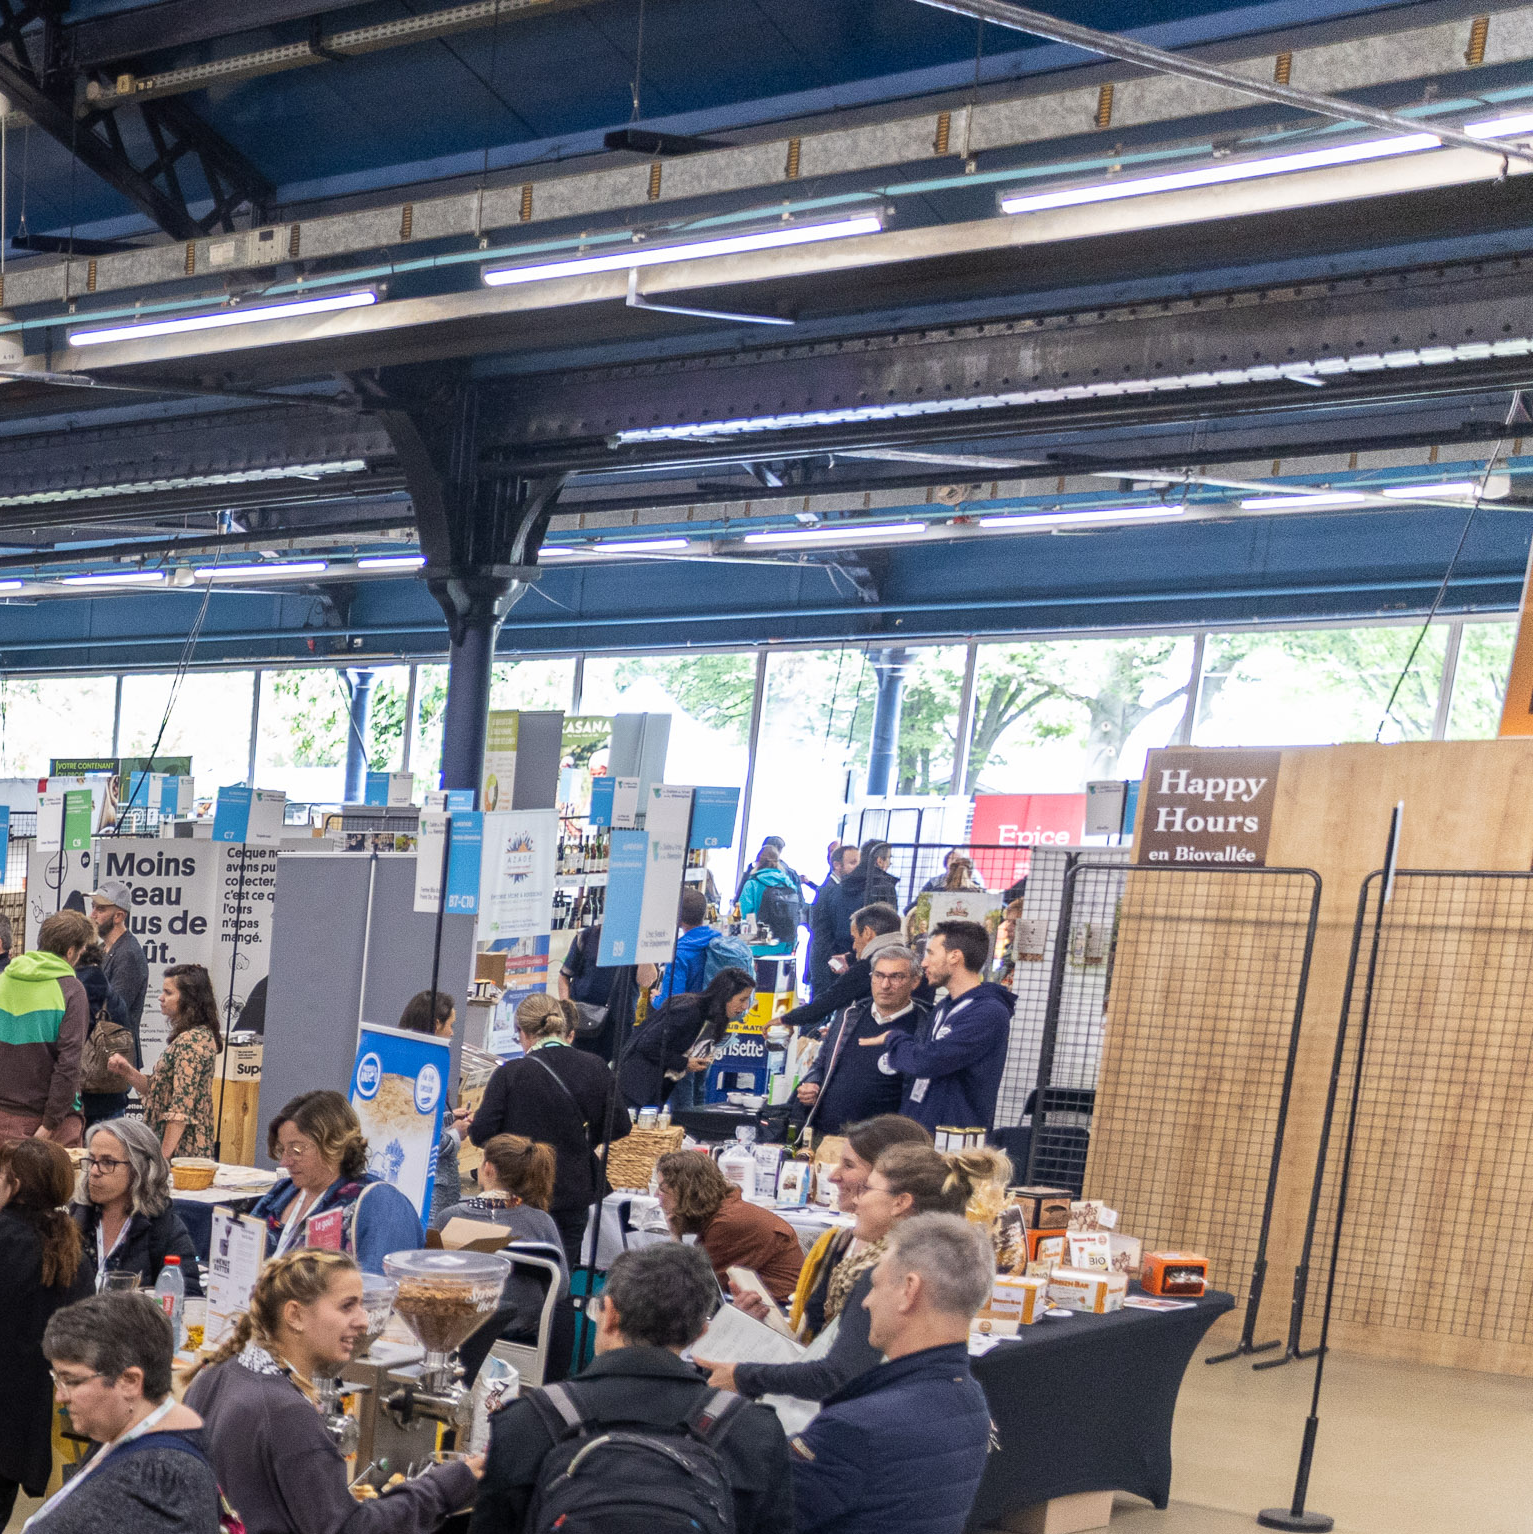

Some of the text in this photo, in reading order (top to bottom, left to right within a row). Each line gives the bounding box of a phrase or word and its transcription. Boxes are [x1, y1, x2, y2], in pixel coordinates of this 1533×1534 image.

[1158, 769, 1268, 802] Happy
[1154, 807, 1259, 833] Hours
[224, 831, 234, 839] C7
[704, 838, 717, 846] C8
[73, 839, 81, 847] C9
[228, 848, 267, 861] Ce que
[1149, 846, 1256, 863] en Biovallée
[106, 851, 196, 877] Moins
[227, 862, 276, 874] avons pu
[226, 876, 276, 888] colecter,
[126, 884, 182, 906] 'eau
[224, 890, 266, 901] c'est ce
[449, 896, 474, 908] B7-C10
[126, 910, 208, 936] lus de
[222, 918, 259, 932] n'a pas
[221, 931, 263, 945] mangé.
[142, 939, 176, 964] ût.
[613, 941, 624, 957] B9
